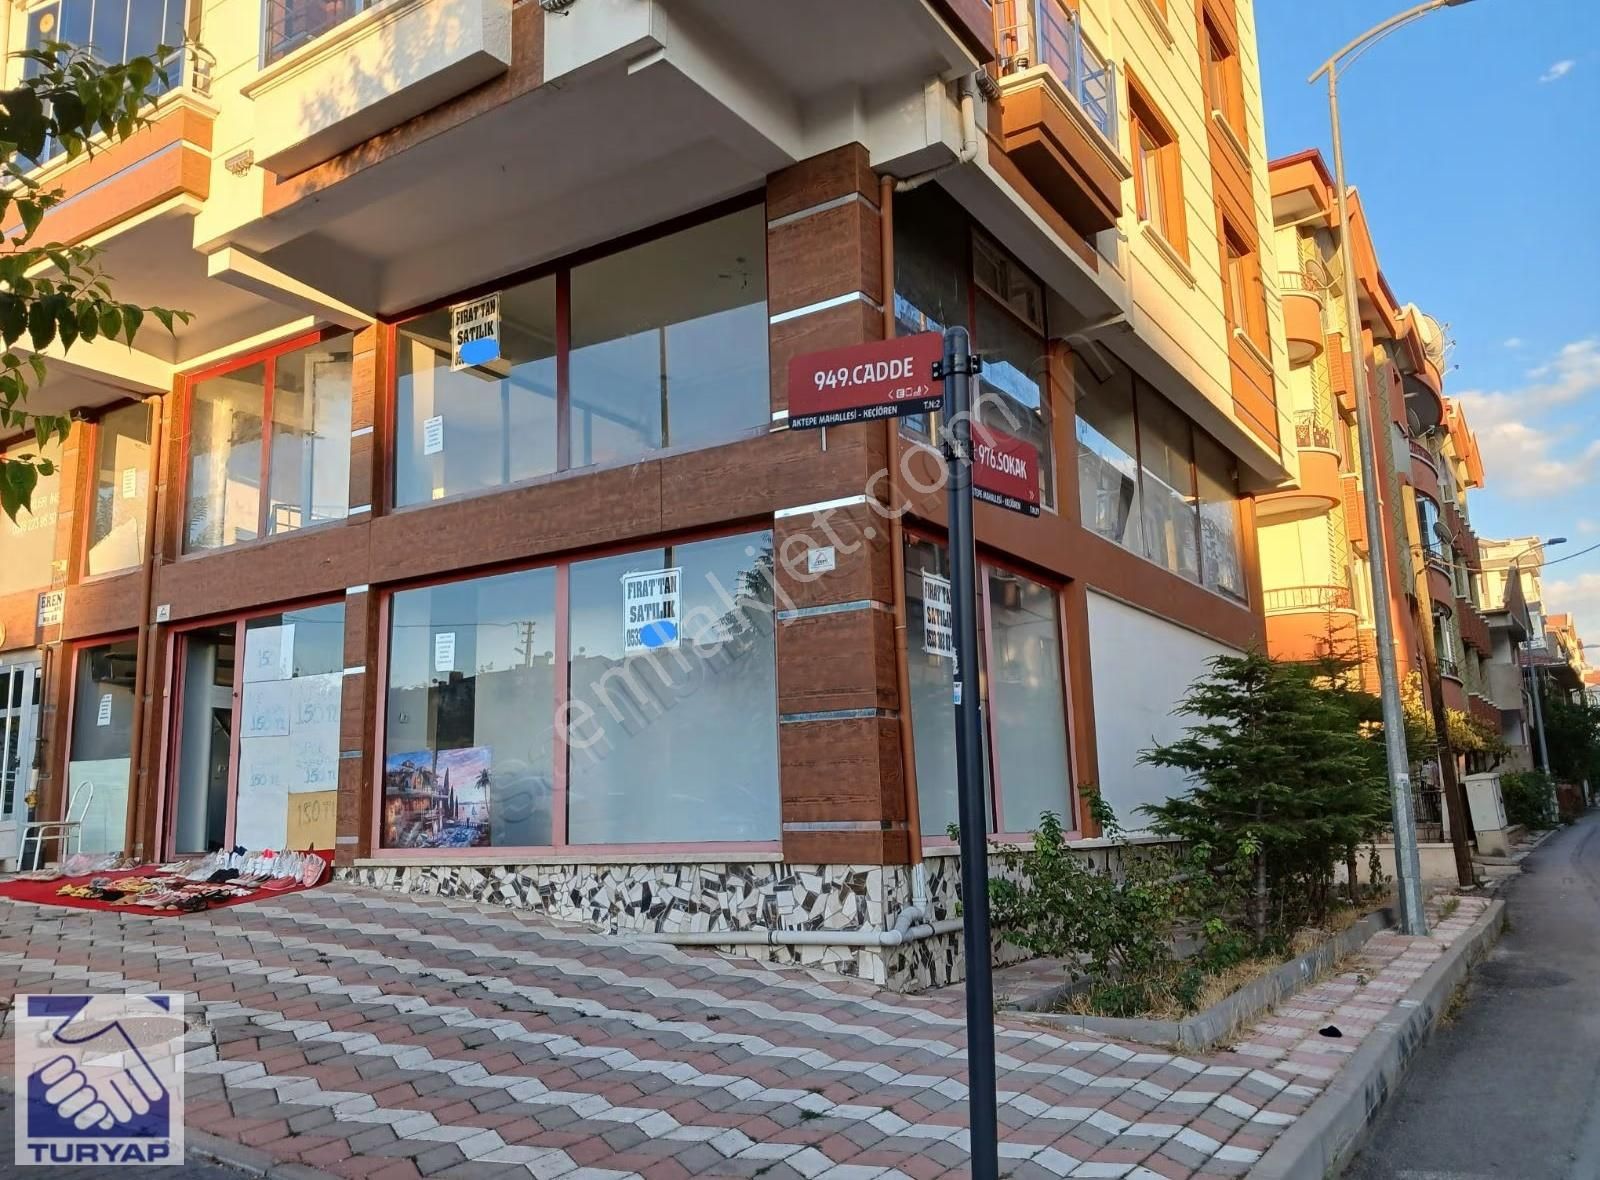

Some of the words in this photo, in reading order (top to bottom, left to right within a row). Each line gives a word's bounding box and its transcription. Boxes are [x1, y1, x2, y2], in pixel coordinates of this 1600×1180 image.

[456, 298, 496, 326] FIRAT'TAN
[457, 320, 494, 345] SATILIK
[814, 356, 914, 391] 949.CADDE
[792, 414, 818, 428] AKTEPE
[818, 409, 857, 424] MAHALLESİ
[863, 405, 898, 420] KEÇİÖREN
[978, 444, 1028, 481] 976.SOKAK
[628, 575, 677, 600] FIRAT'TAN
[41, 593, 63, 609] EREN
[630, 600, 676, 624] SATILIK
[297, 799, 321, 826] 150
